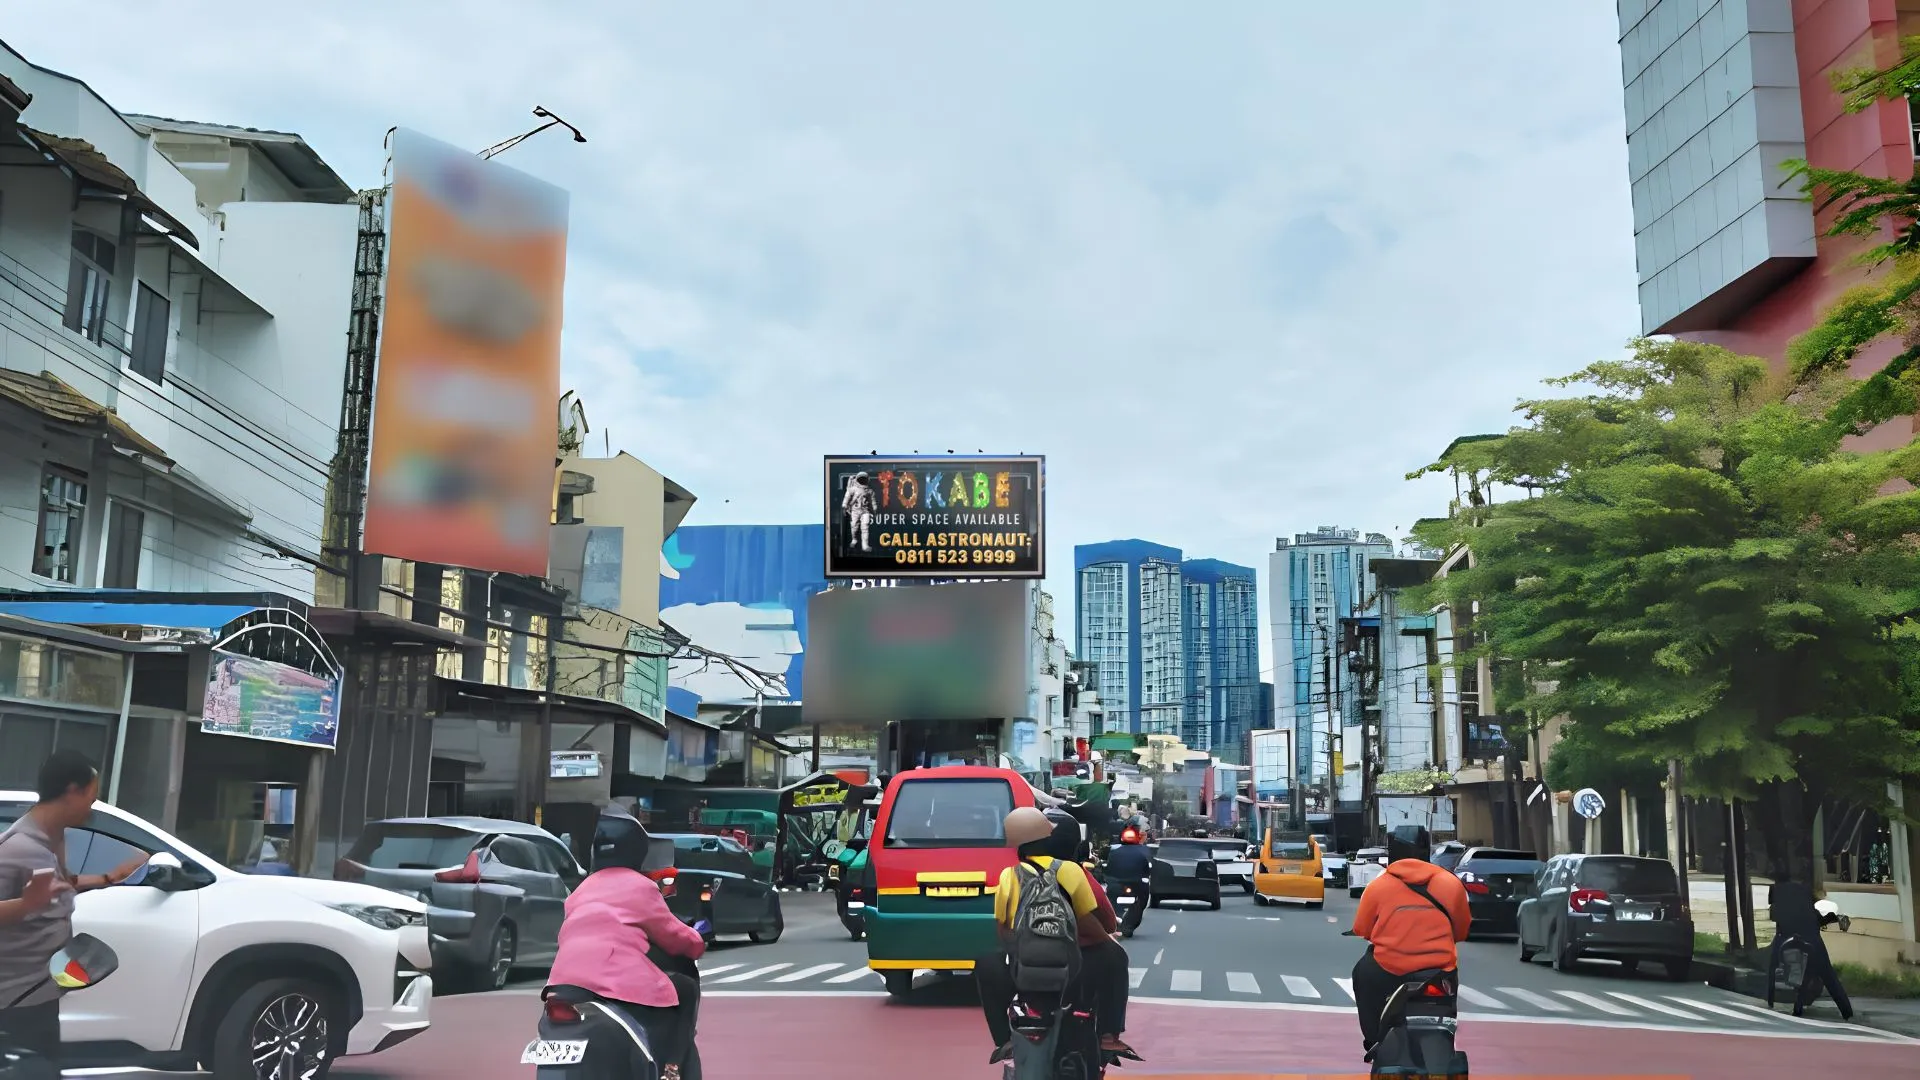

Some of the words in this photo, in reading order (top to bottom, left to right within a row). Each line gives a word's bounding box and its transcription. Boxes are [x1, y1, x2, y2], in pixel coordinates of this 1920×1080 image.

[878, 470, 1010, 509] TOKABE
[869, 513, 906, 525] SUPER
[912, 513, 949, 525] SPACE
[955, 513, 1020, 525] AVAILABLE
[879, 532, 921, 547] CALL
[926, 532, 1032, 547] ASTRONAUT:
[895, 549, 932, 564] 0811
[937, 549, 968, 564] 523
[972, 549, 1016, 564] 9999
